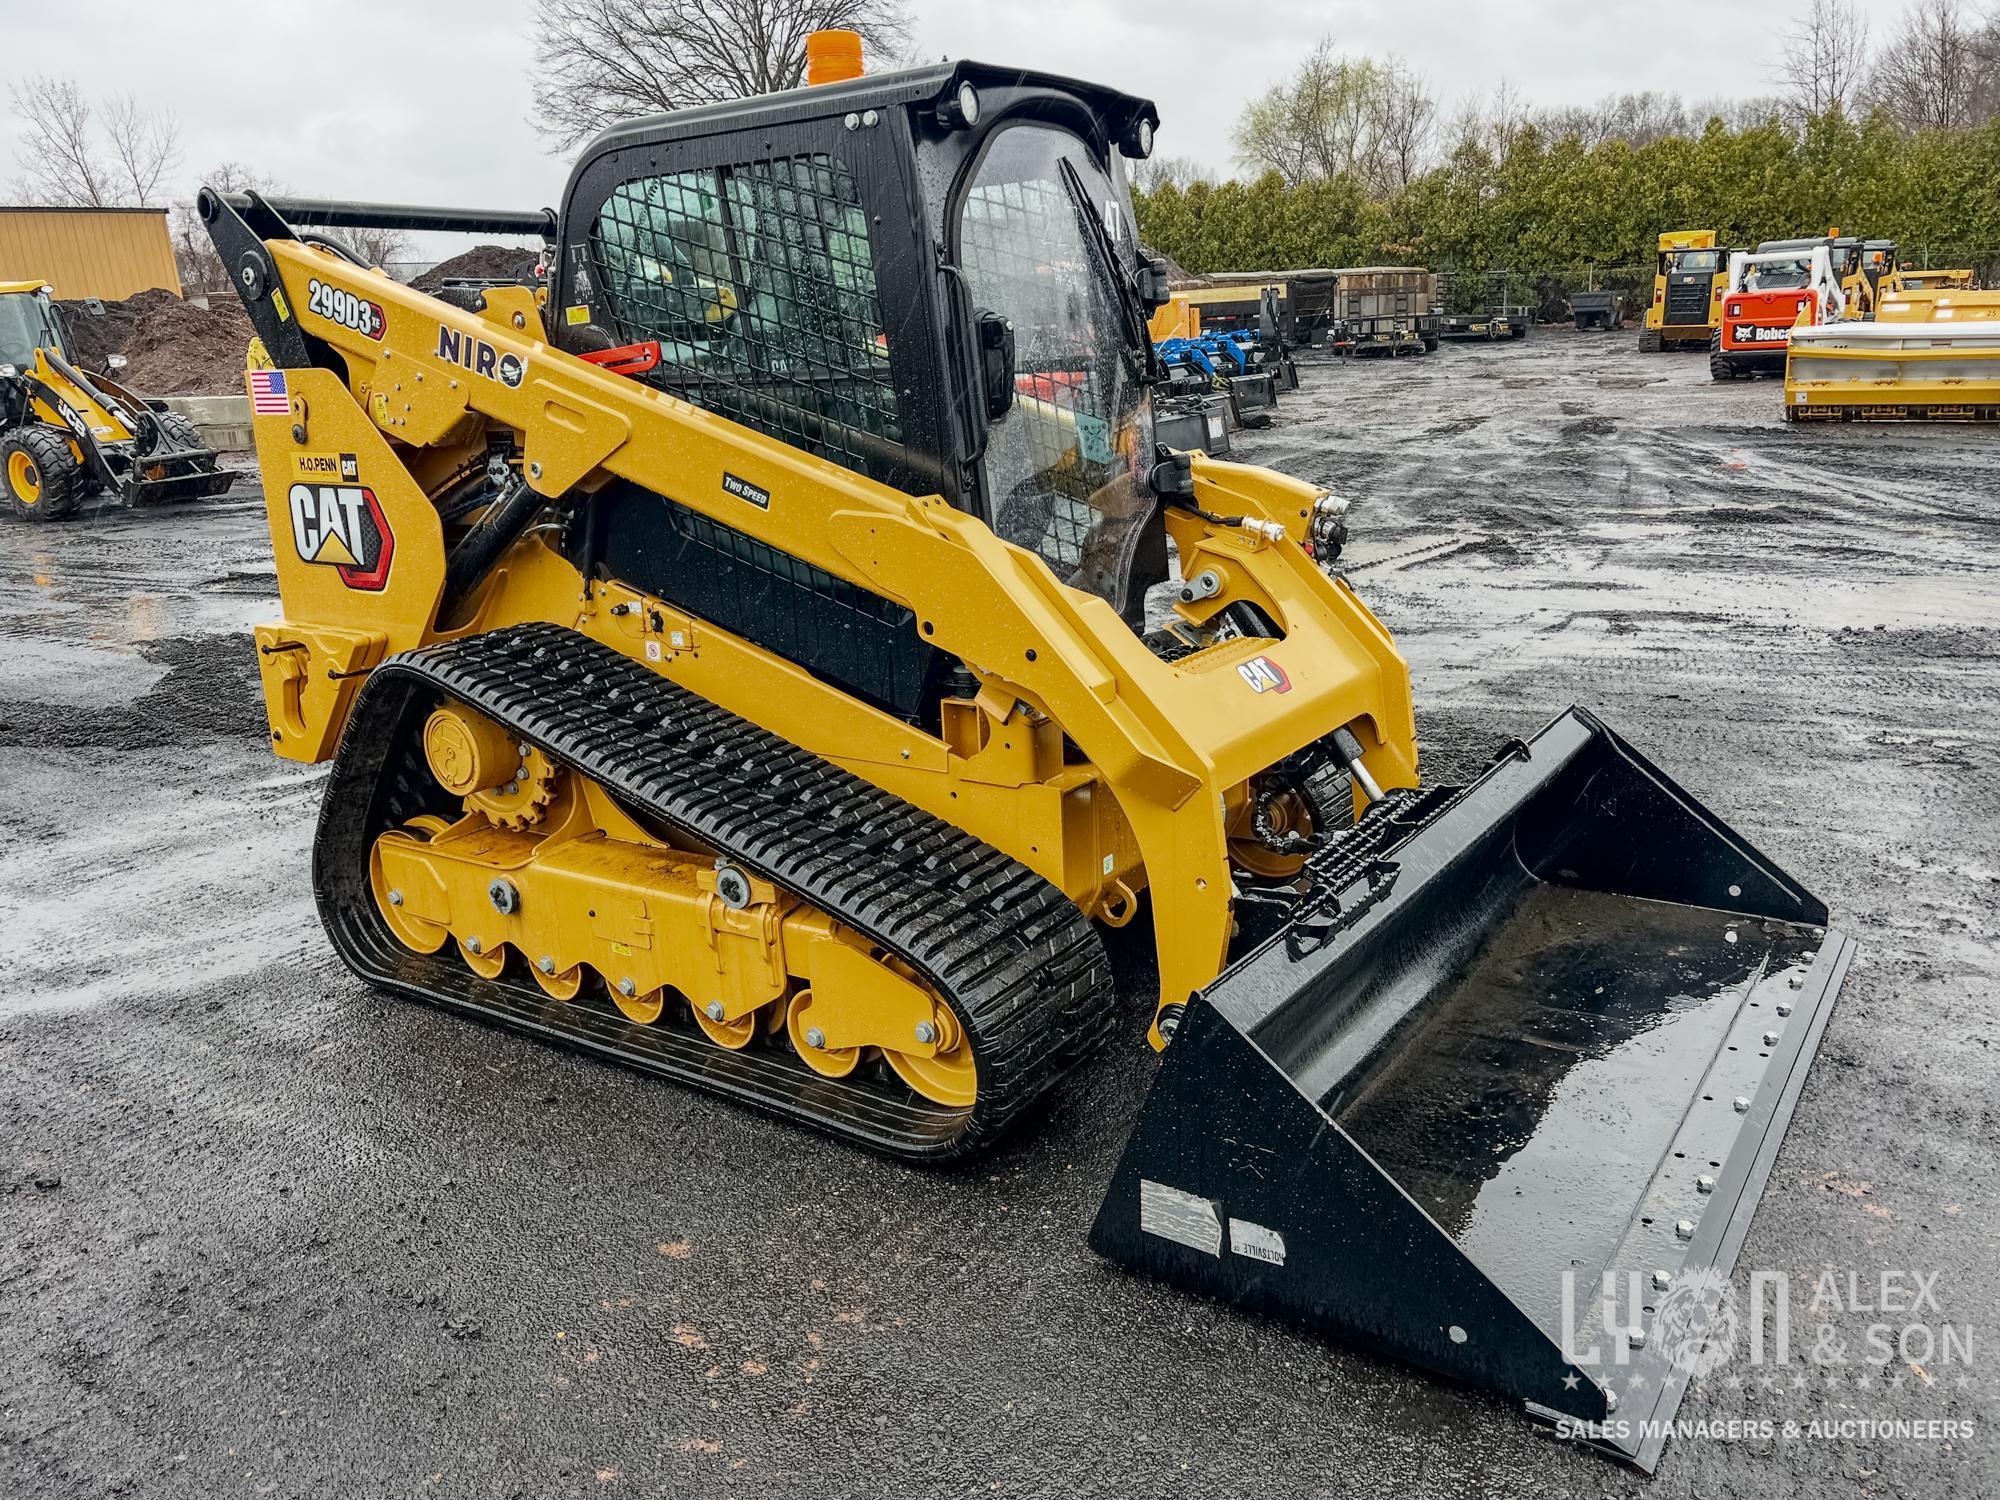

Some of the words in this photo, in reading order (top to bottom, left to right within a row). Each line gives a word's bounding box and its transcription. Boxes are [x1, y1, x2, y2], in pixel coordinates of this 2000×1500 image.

[309, 279, 372, 335] 299D3
[371, 315, 381, 330] XE
[1755, 327, 1791, 340] Bobca
[58, 399, 86, 438] JCB
[341, 460, 357, 475] CAT
[289, 484, 365, 566] CAT
[1237, 657, 1281, 693] CAT
